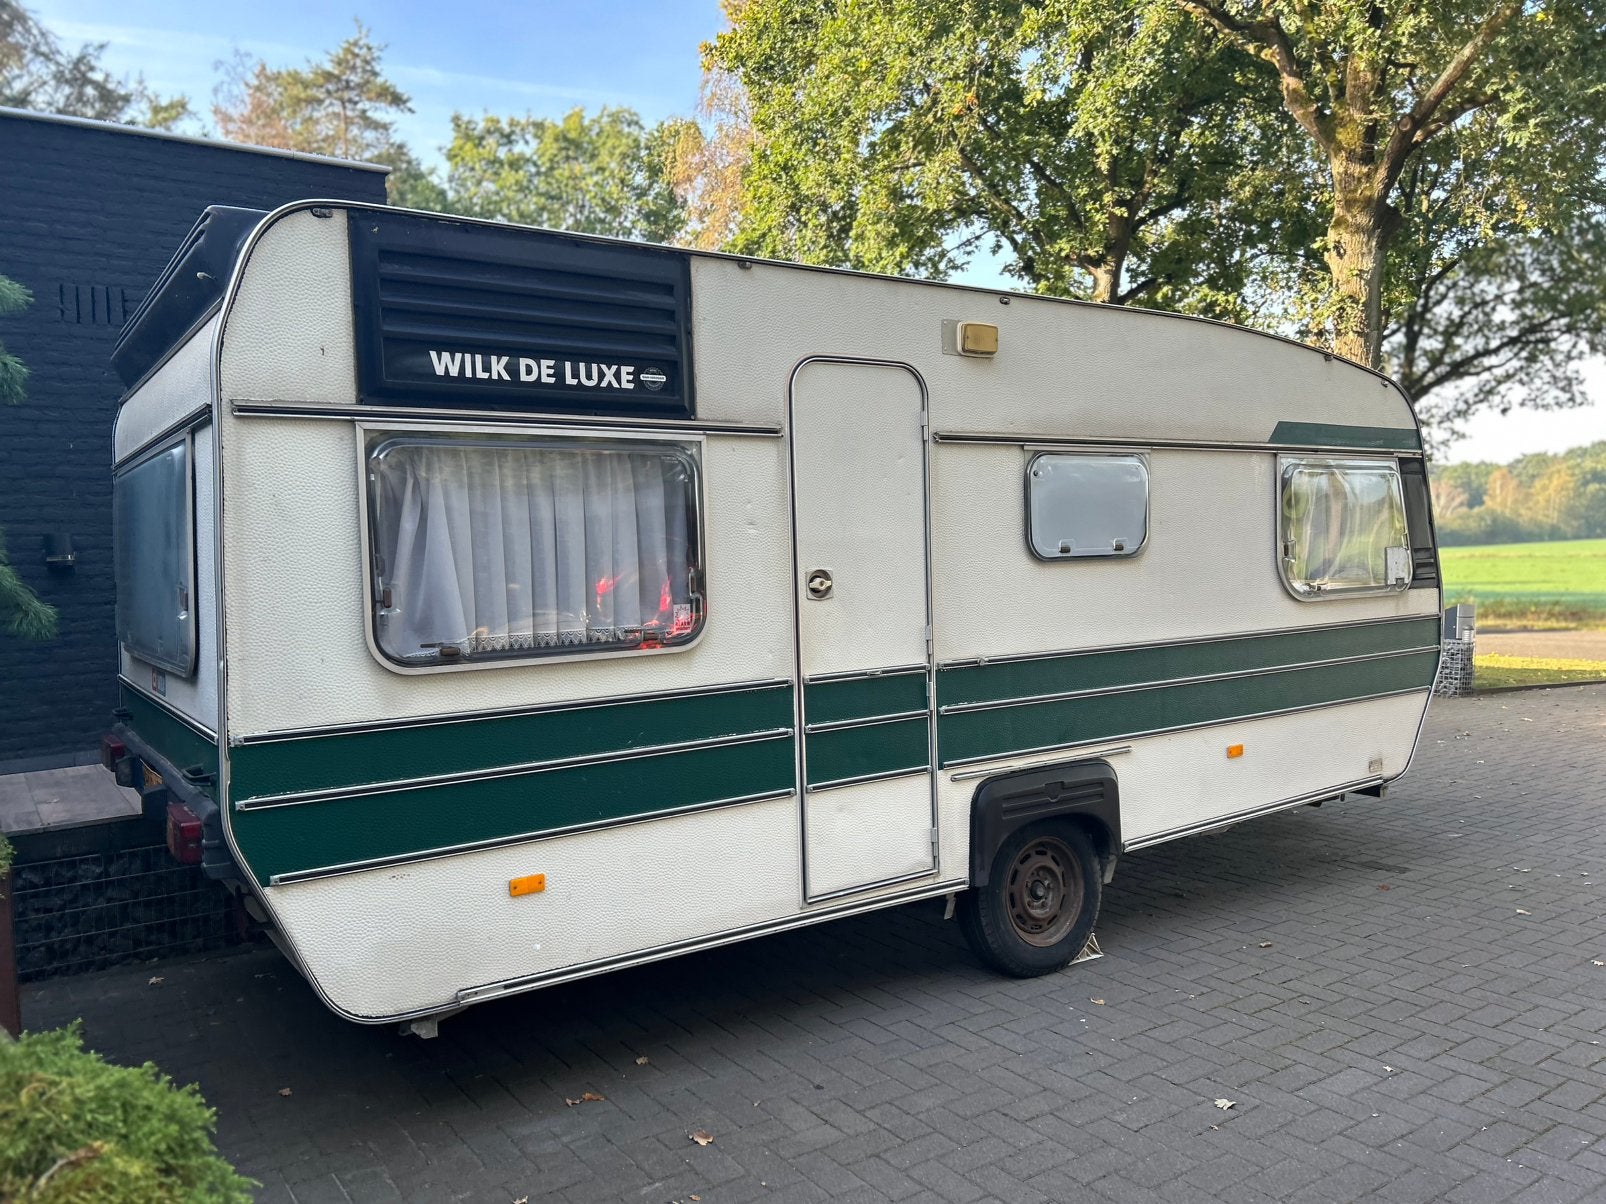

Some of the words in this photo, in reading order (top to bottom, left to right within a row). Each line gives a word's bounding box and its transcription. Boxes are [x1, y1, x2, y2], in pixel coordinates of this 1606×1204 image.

[429, 350, 511, 381] WILK
[519, 357, 556, 384] DE
[564, 361, 635, 389] LUXE
